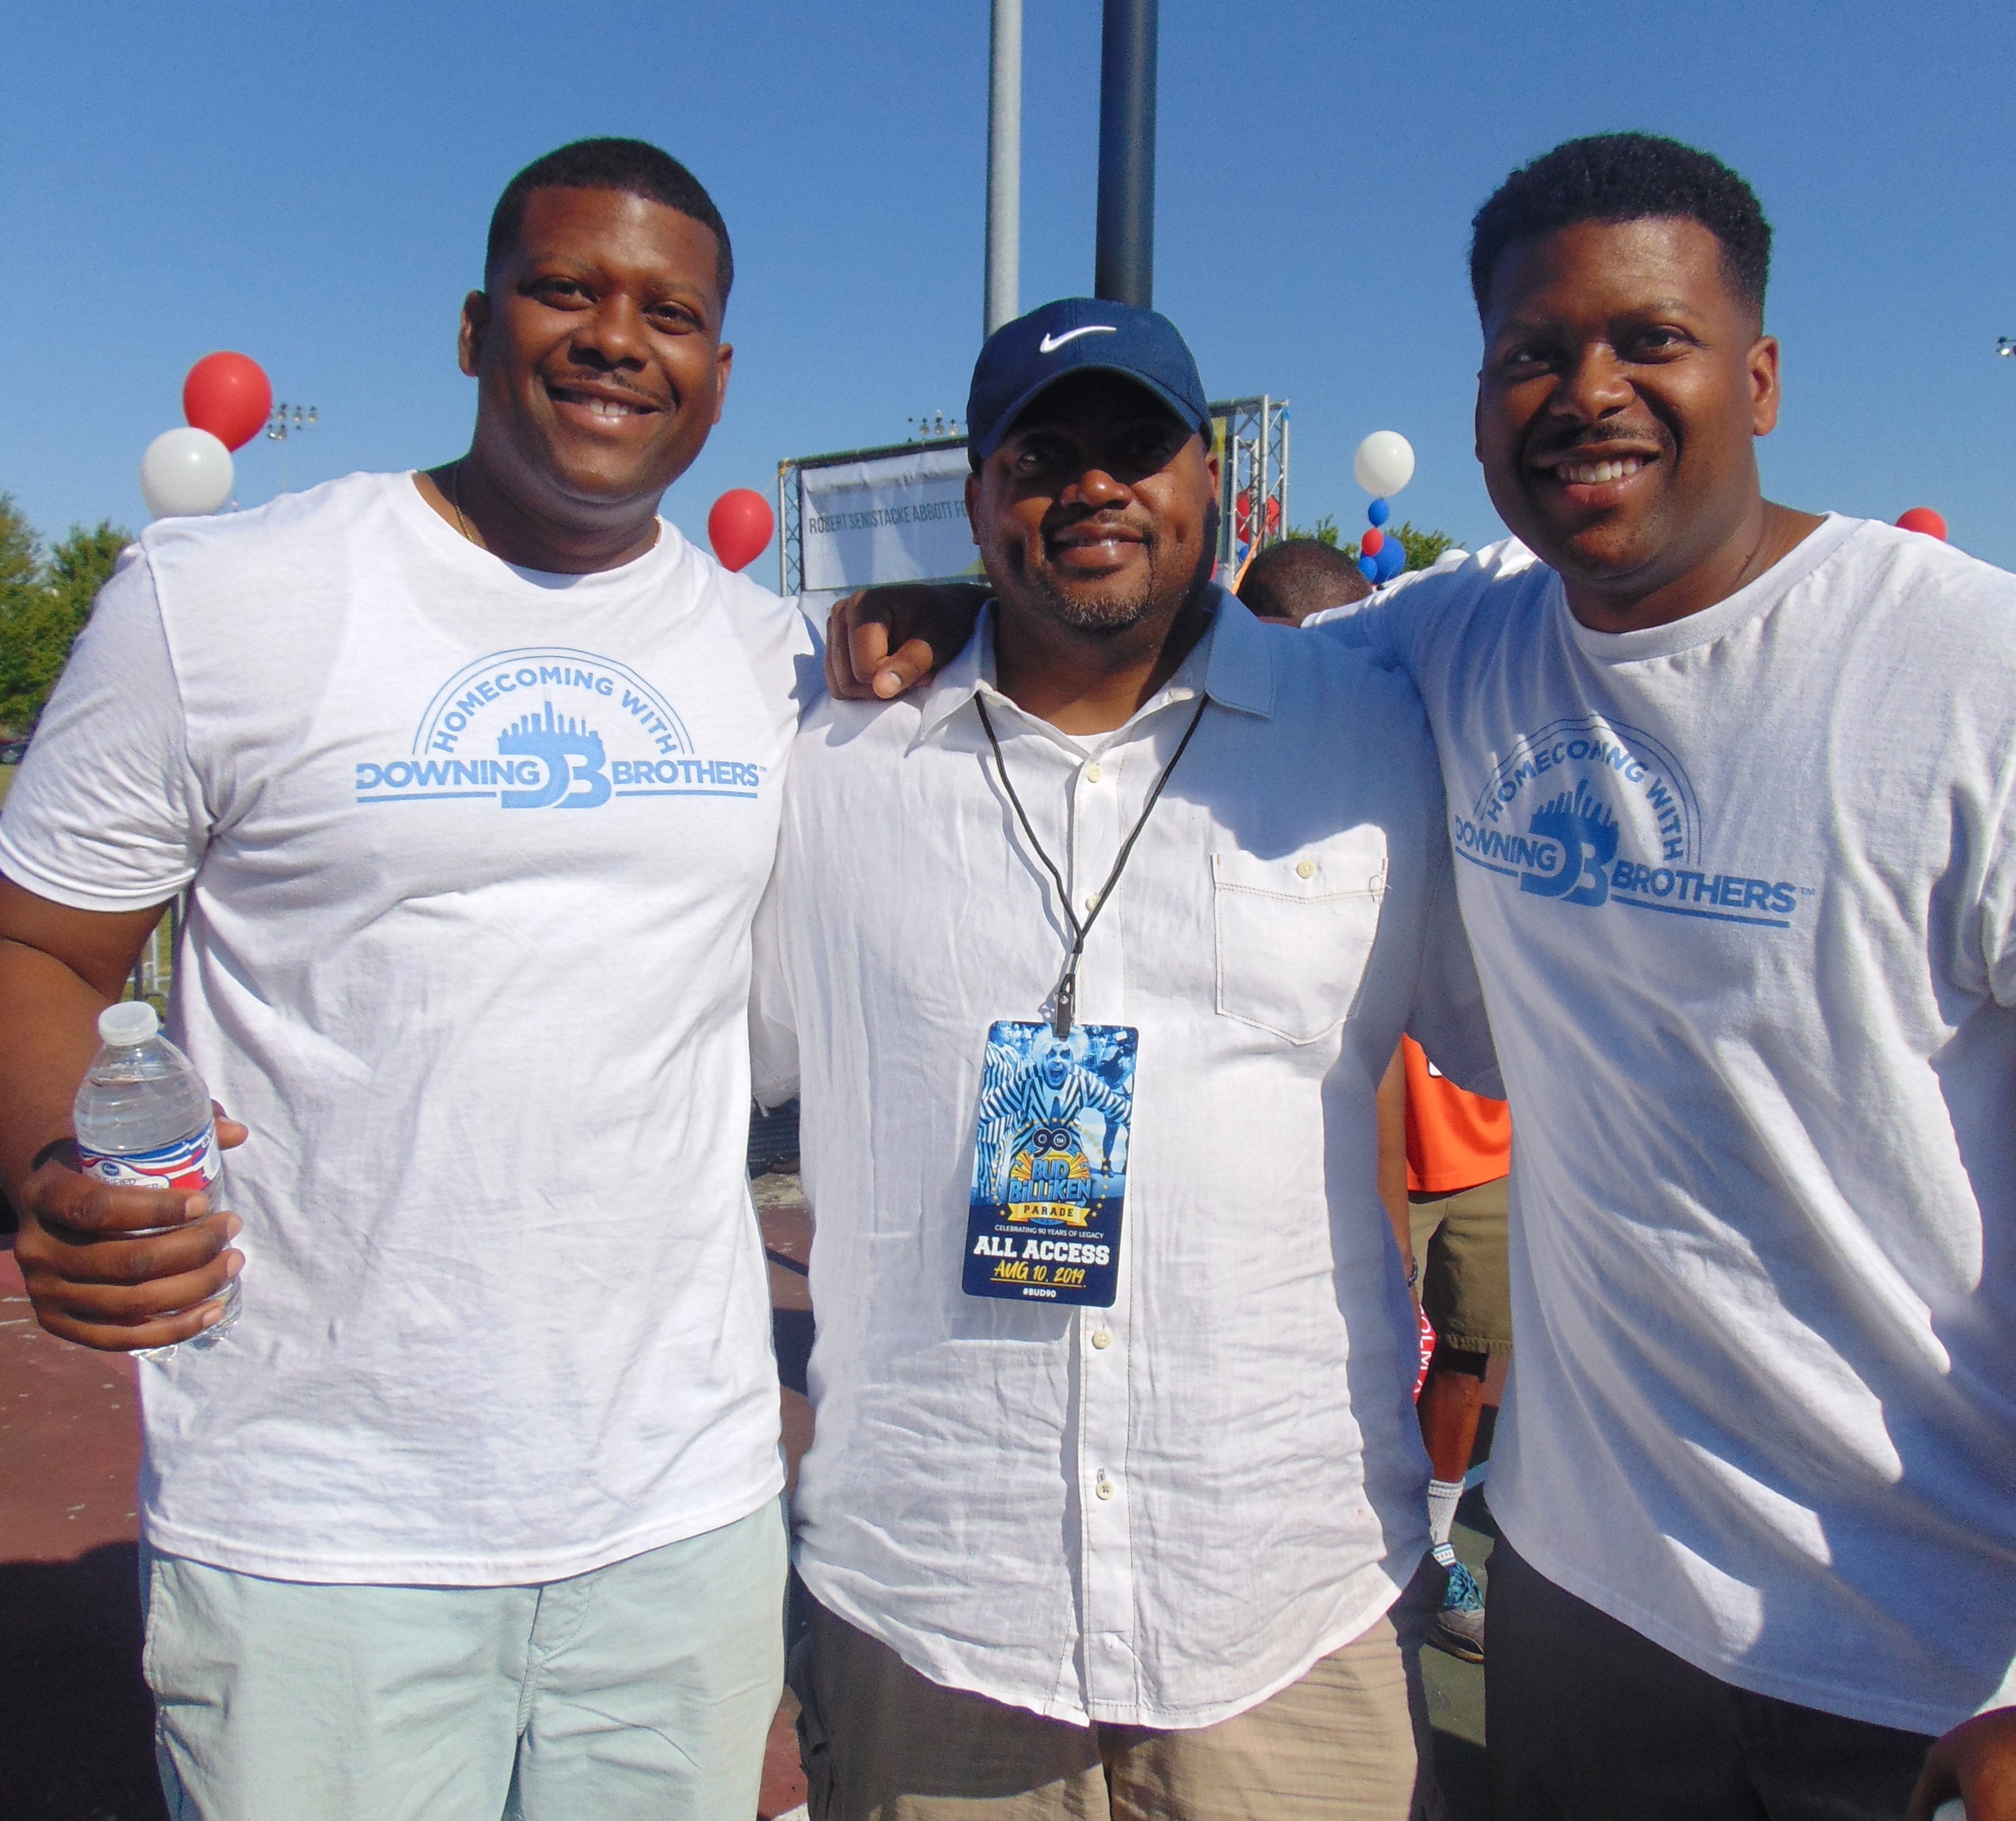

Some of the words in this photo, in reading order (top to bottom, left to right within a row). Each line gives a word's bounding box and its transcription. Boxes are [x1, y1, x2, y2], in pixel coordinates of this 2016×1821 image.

[809, 514, 847, 533] ROBERT
[912, 501, 952, 521] ABBOTT
[433, 667, 614, 752] HOMECOMING
[622, 689, 677, 754] WITH
[356, 760, 541, 789] DOWNING
[612, 759, 759, 787] BROTHERS
[1487, 740, 1649, 823] HOMECOMNG
[1646, 777, 1683, 861] WITH
[1611, 860, 1797, 913] BROTHERS
[1032, 1159, 1070, 1180] BUD
[1024, 1205, 1074, 1217] PARADE
[995, 1224, 1037, 1234] CELEBRATING
[1047, 1229, 1067, 1237] YEARS
[973, 1235, 1018, 1258] ALL
[1022, 1239, 1111, 1266] ACCESS
[993, 1259, 1029, 1280] AUG
[1053, 1266, 1086, 1284] 2019
[1022, 1288, 1057, 1298] #BUD90
